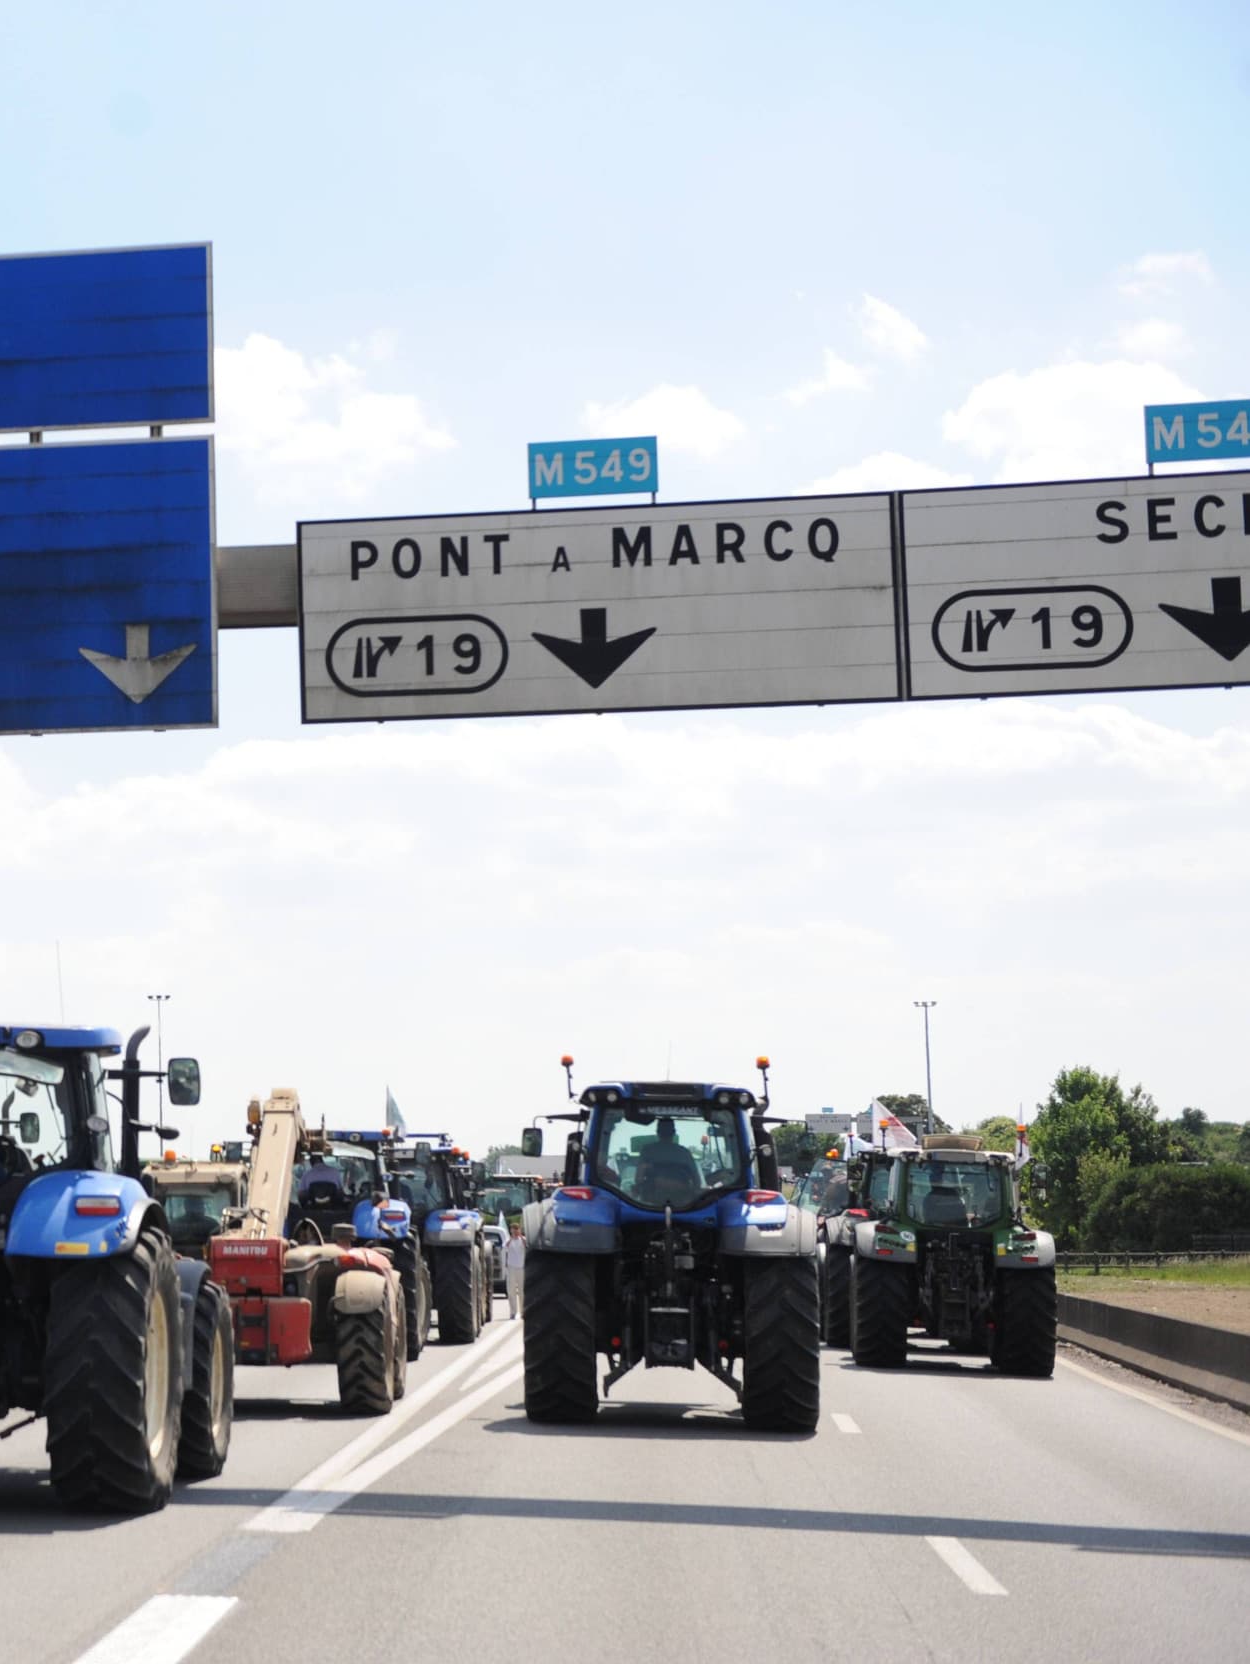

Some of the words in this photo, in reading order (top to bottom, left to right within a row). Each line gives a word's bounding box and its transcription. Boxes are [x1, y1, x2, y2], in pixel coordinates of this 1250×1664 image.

[350, 533, 510, 581] PONT
[550, 546, 572, 573] A
[611, 517, 840, 569] MARCQ
[1030, 604, 1104, 650] 19
[415, 632, 482, 676] 19
[222, 1245, 269, 1256] MANITOU
